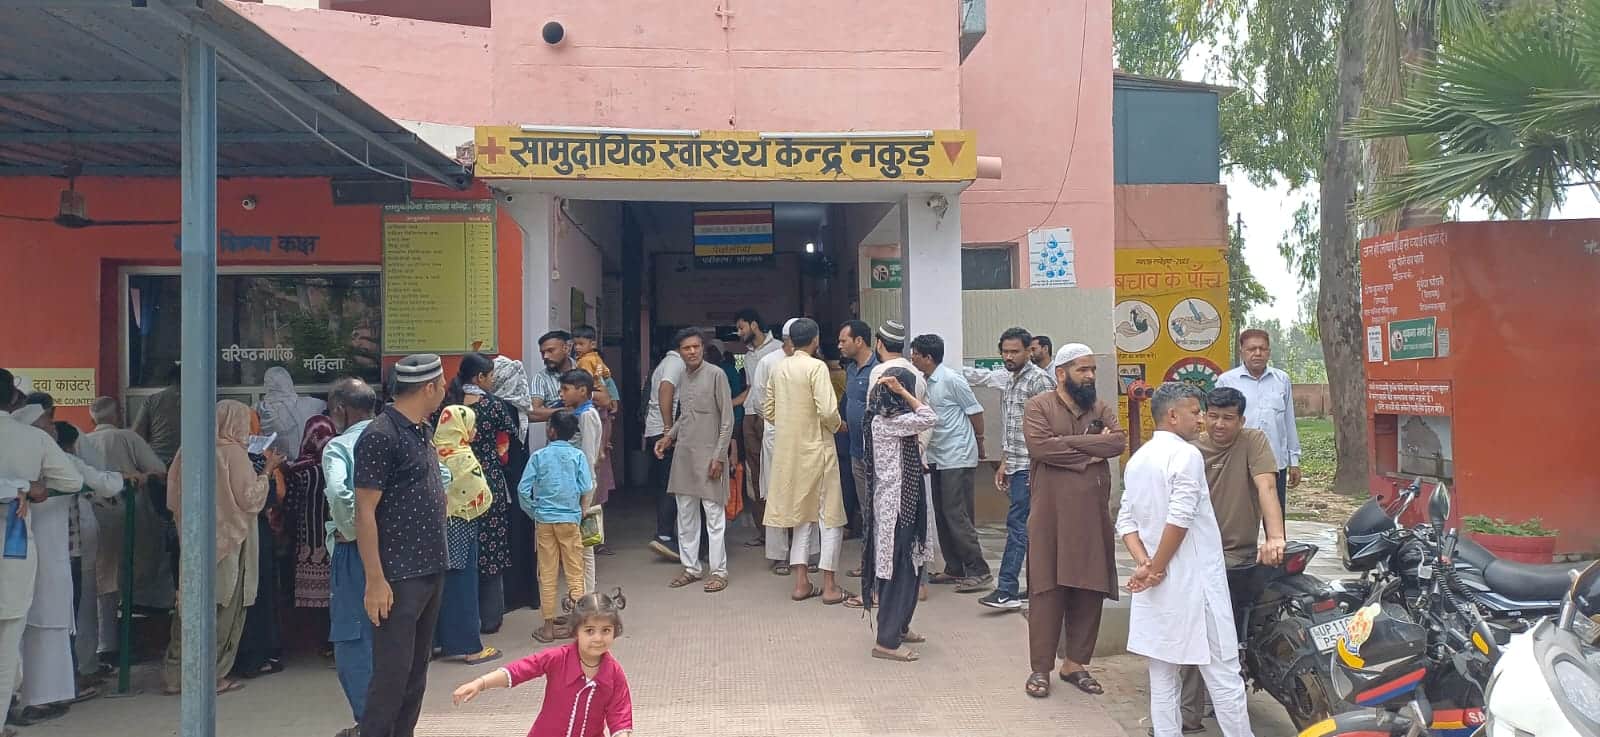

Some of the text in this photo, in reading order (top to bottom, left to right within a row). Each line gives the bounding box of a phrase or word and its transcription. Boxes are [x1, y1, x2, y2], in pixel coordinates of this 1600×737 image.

[510, 134, 934, 177] सामुदायिक स्वास्थ्य केन्द्र नकुड़
[1115, 272, 1161, 291] बचाव
[1164, 264, 1182, 289] के
[221, 344, 294, 362] वरिष्ठ नागरिक
[303, 354, 346, 373] महिला
[32, 379, 52, 393] दवा
